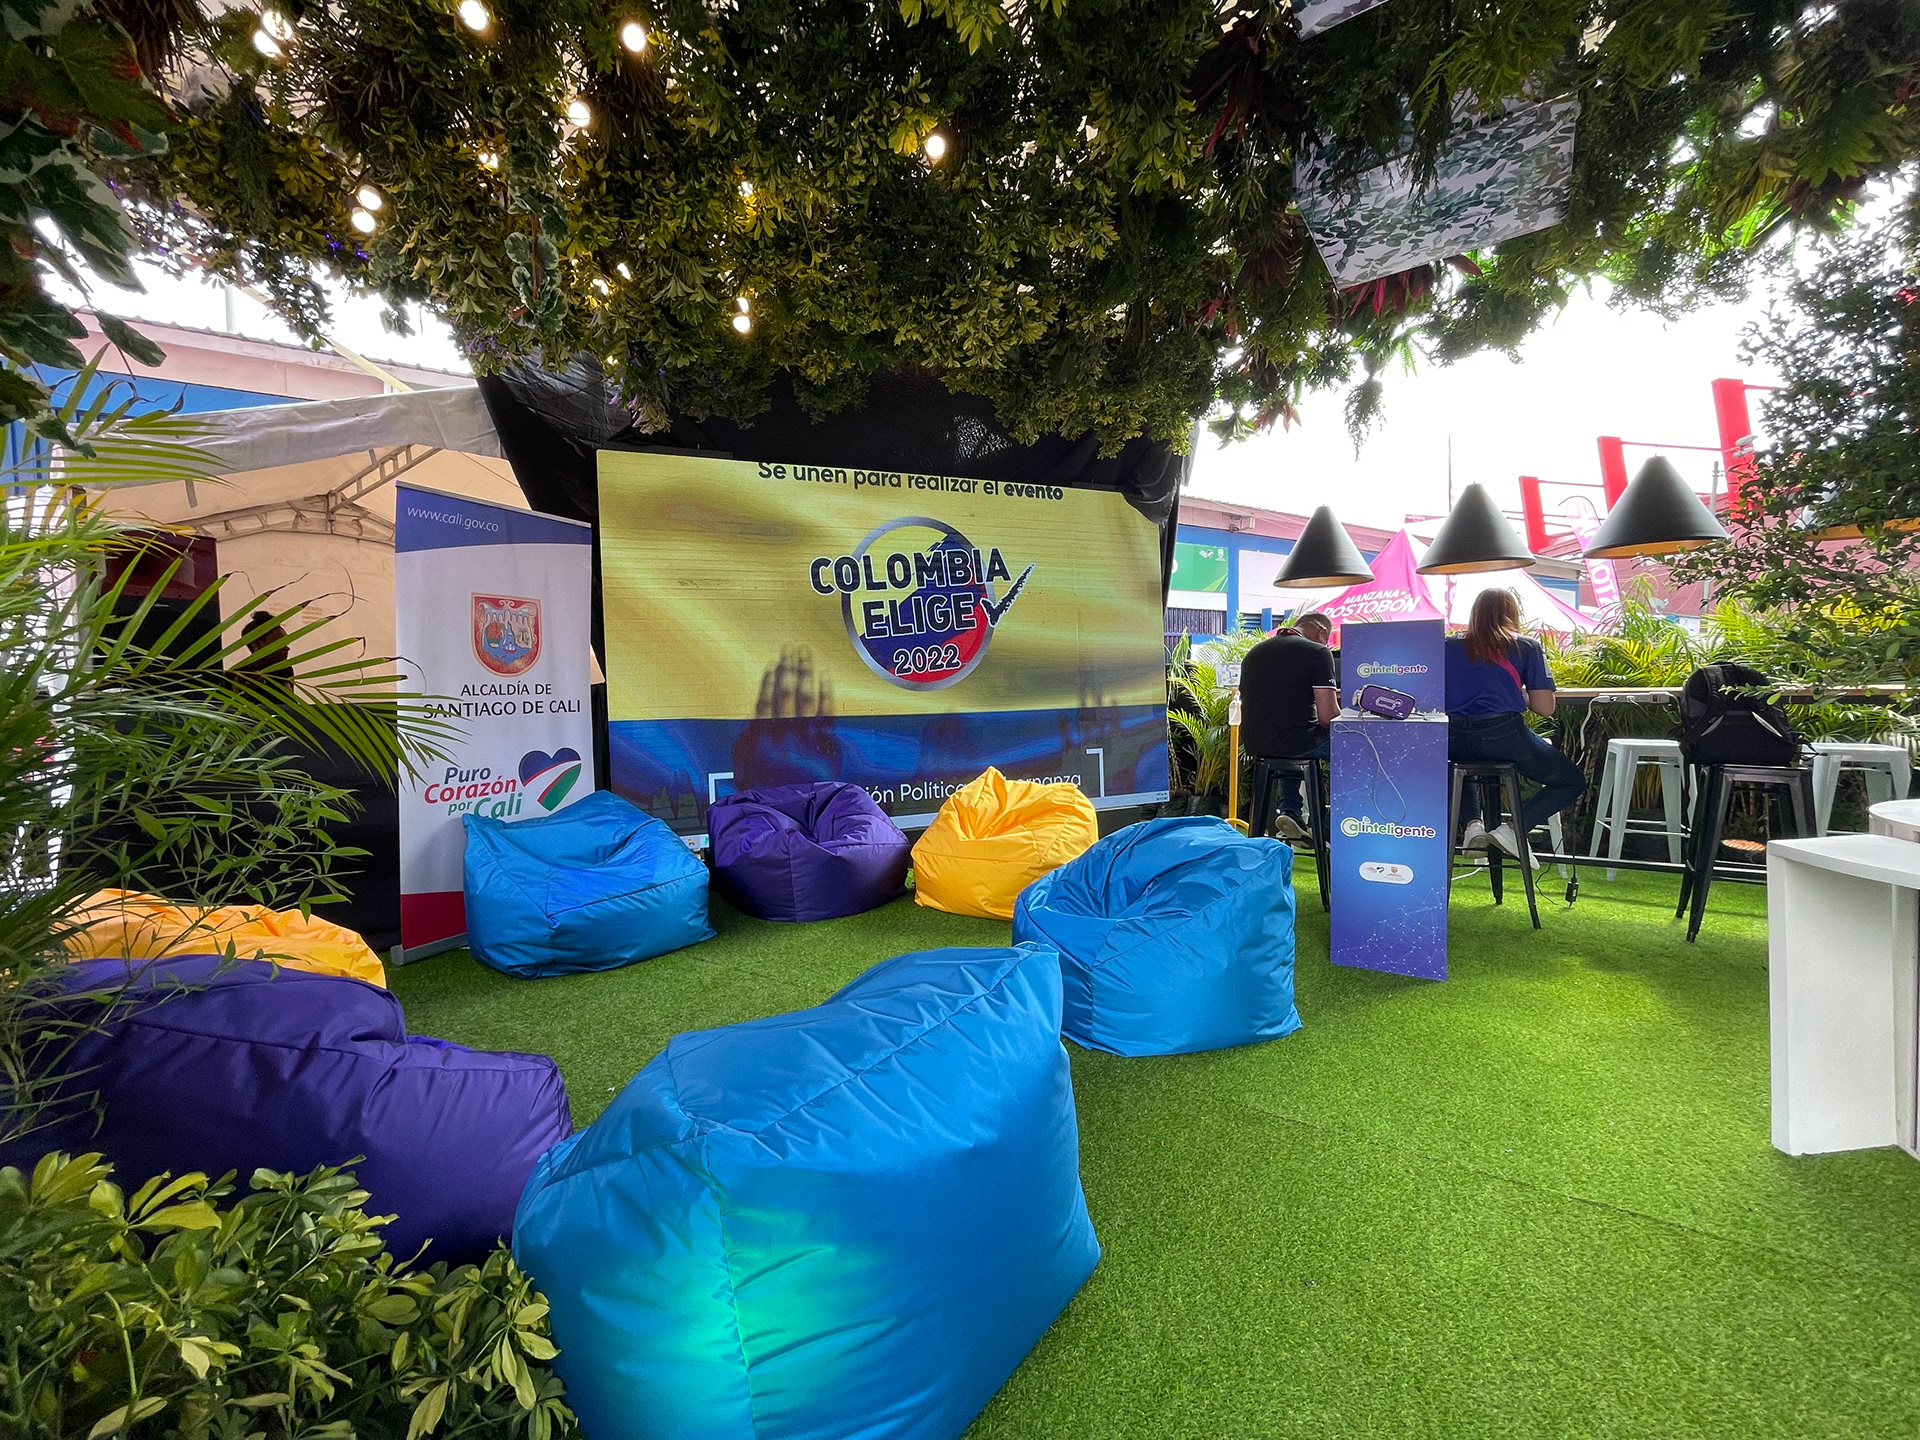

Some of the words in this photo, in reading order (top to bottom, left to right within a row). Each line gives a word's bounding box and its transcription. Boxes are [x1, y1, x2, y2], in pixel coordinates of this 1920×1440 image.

[758, 462, 787, 479] Se
[793, 465, 848, 483] unen
[853, 470, 901, 489] para
[908, 474, 978, 493] realizar
[983, 480, 999, 495] el
[1003, 483, 1064, 500] evento
[407, 506, 499, 533] www.cali.gov.co
[810, 548, 1012, 595] COLOMBIA
[1343, 588, 1400, 605] MANZANA
[861, 592, 977, 640] ELIGE
[894, 644, 961, 676] 2022
[460, 680, 530, 697] ALCALDÍA
[535, 683, 552, 695] DE
[423, 701, 517, 719] SANTIAGO
[522, 700, 544, 714] DE
[549, 700, 581, 713] CALI
[444, 766, 491, 785] Puro
[424, 775, 517, 804] Corazón
[448, 801, 473, 816] por
[473, 792, 523, 819] Cali
